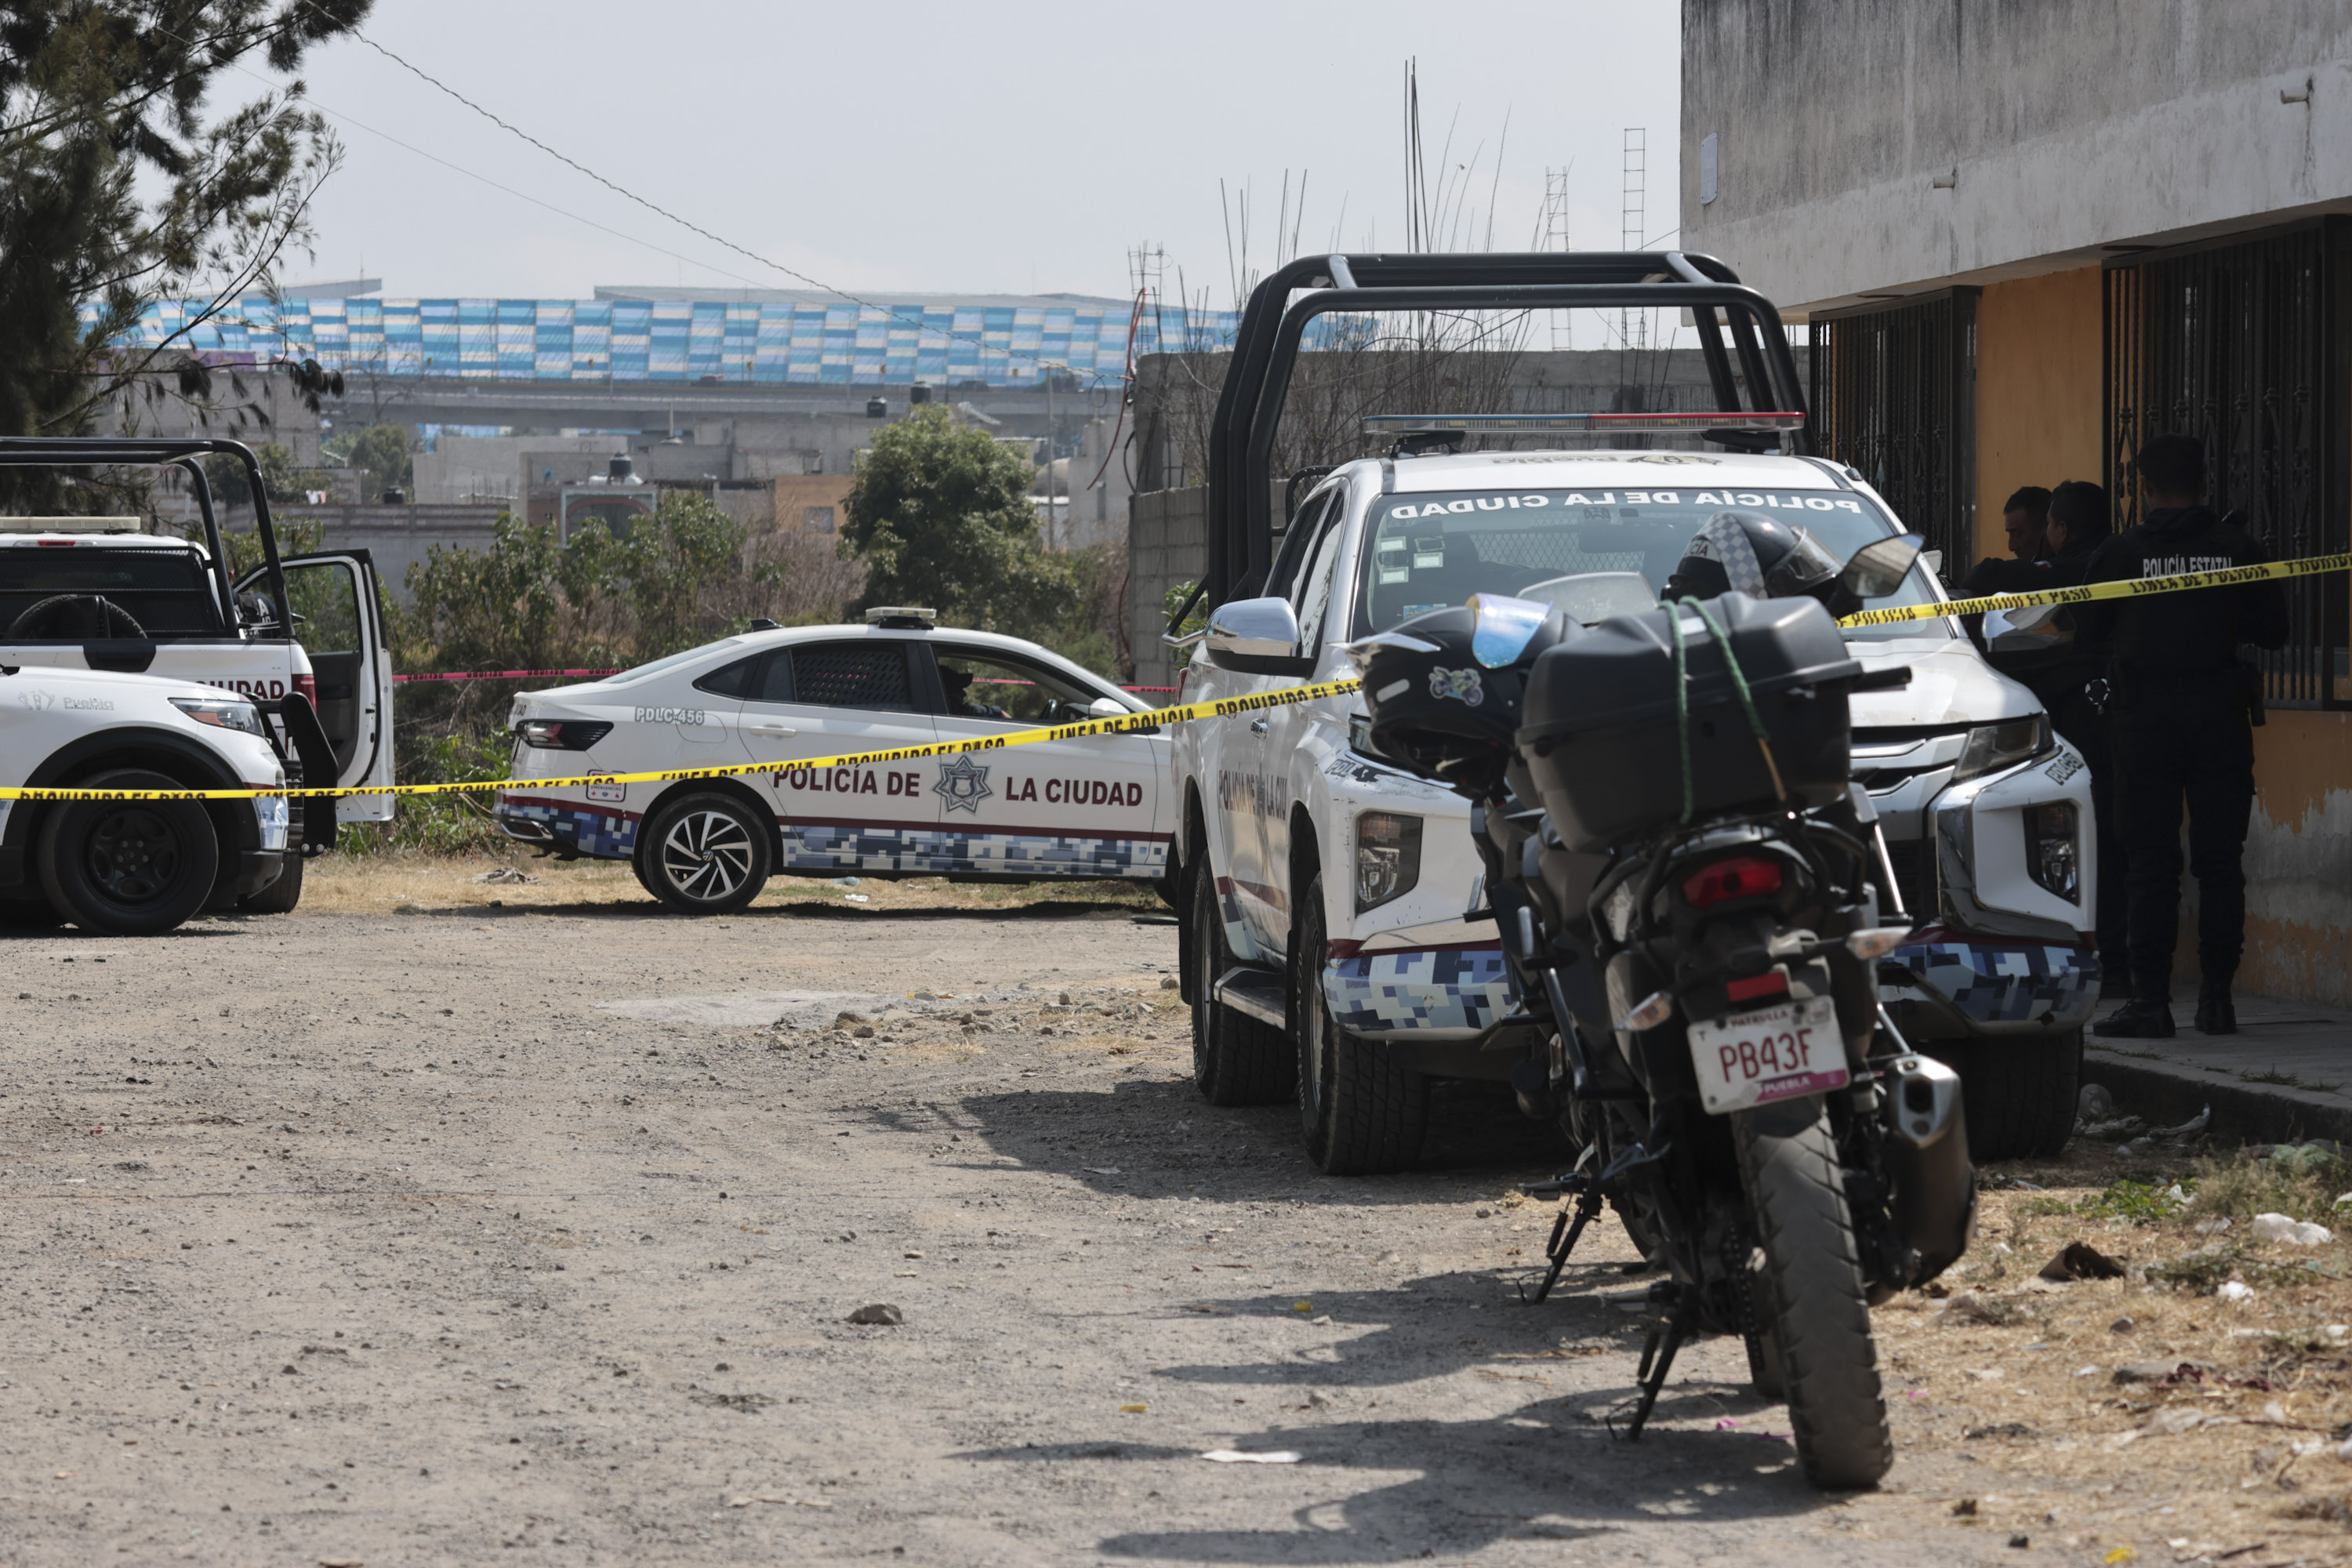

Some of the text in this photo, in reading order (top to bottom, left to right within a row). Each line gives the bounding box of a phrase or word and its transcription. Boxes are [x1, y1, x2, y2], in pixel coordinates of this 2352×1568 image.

[2143, 554, 2186, 578] POLICÍA
[634, 706, 704, 726] PDLC-456
[773, 763, 1142, 807] POLICÍA DE LA CIUDAD
[1731, 1010, 1788, 1028] PATRULLA
[1719, 1028, 1813, 1083] PB43F
[1764, 1077, 1812, 1094] PUEBLA
